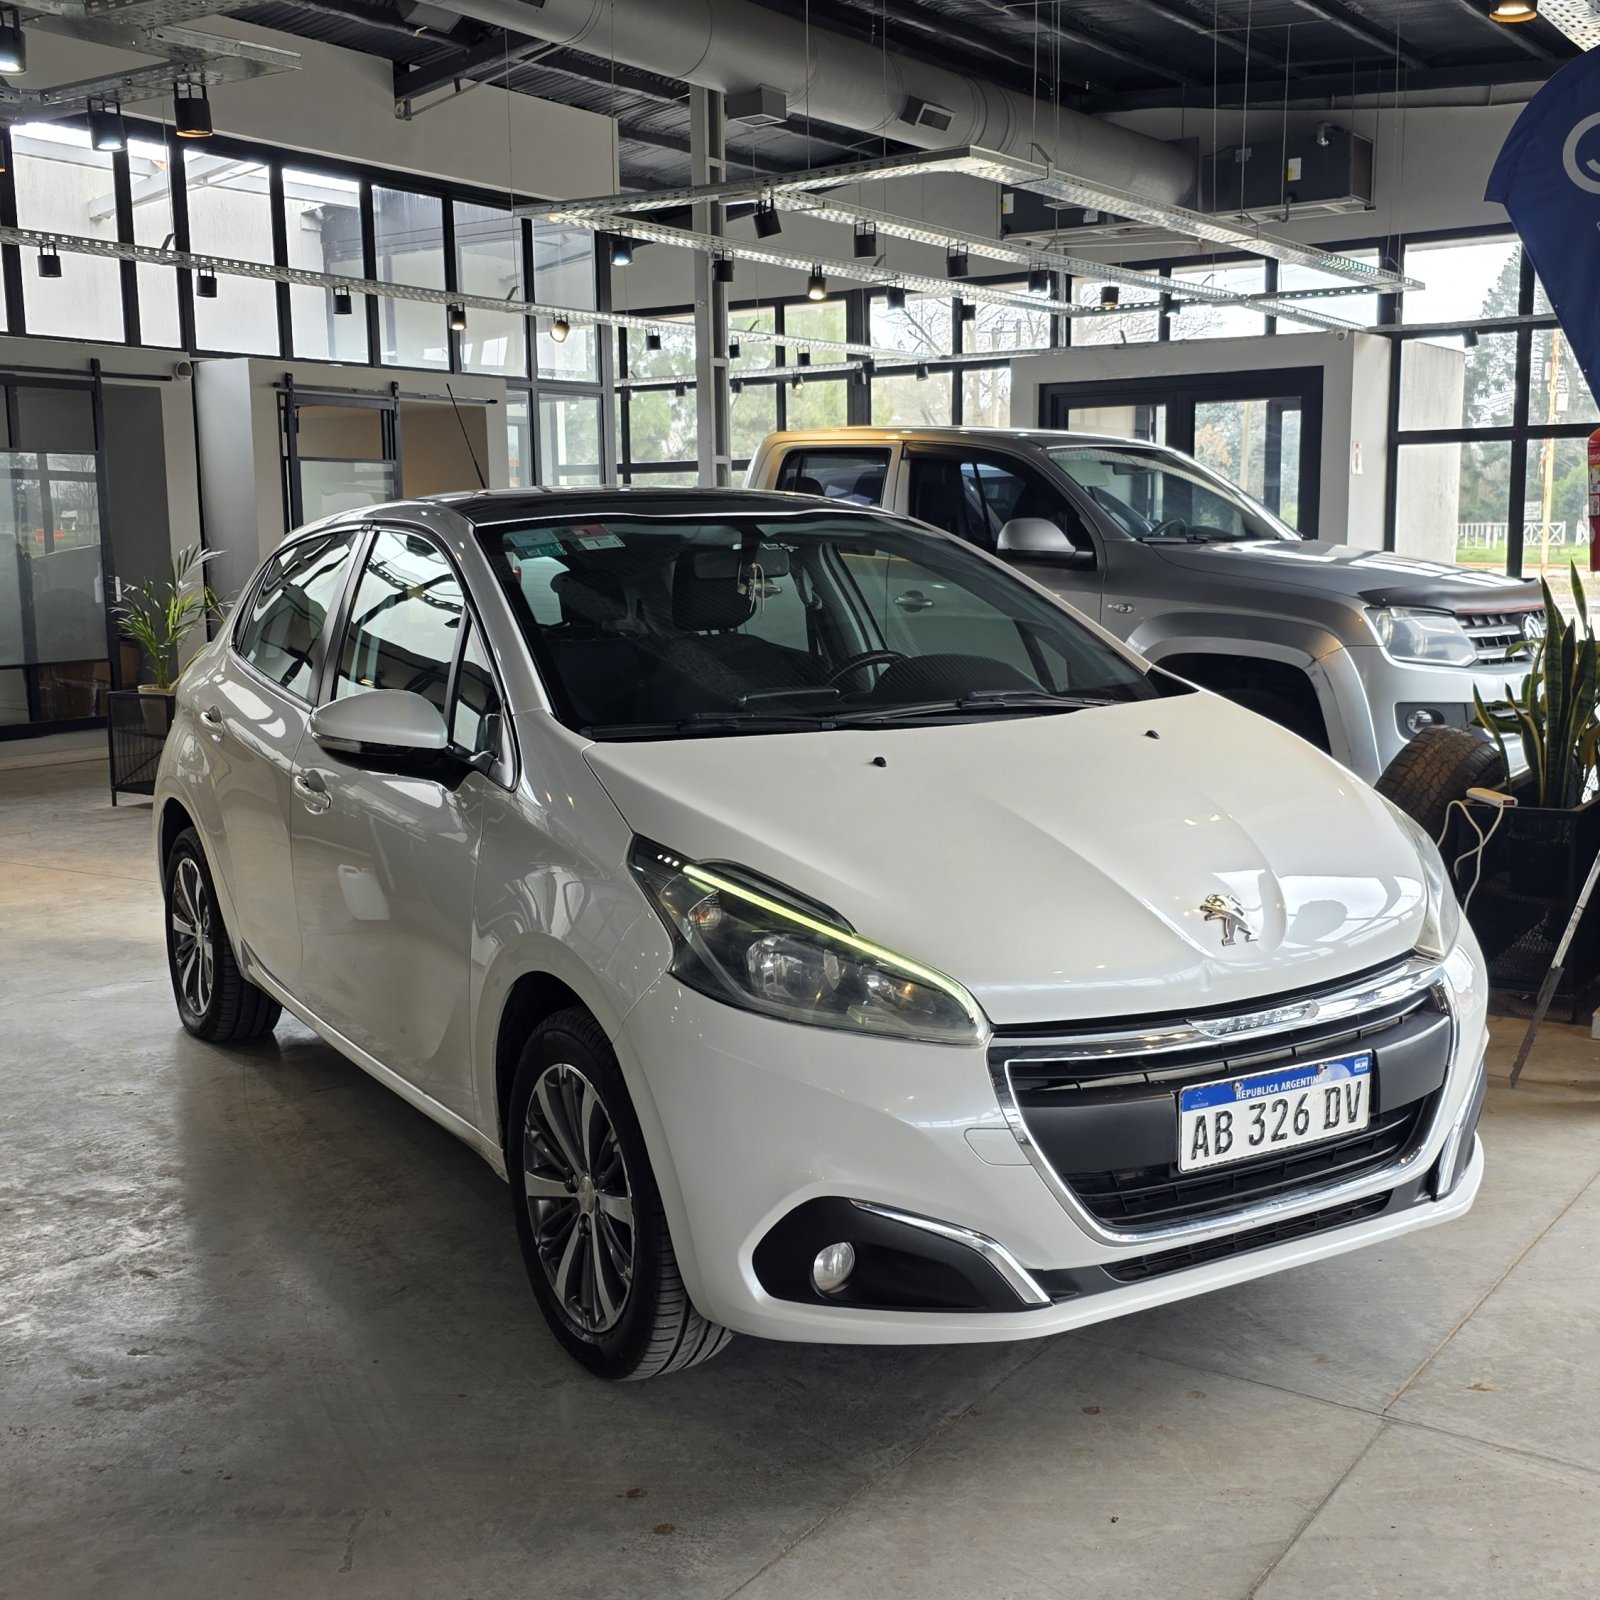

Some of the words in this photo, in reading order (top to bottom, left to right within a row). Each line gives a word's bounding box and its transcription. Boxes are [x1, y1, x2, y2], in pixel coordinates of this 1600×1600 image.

[1236, 1083, 1279, 1100] REPUBLICA
[1191, 1110, 1233, 1160] AB
[1249, 1093, 1309, 1146] 326
[1323, 1081, 1362, 1130] DV
